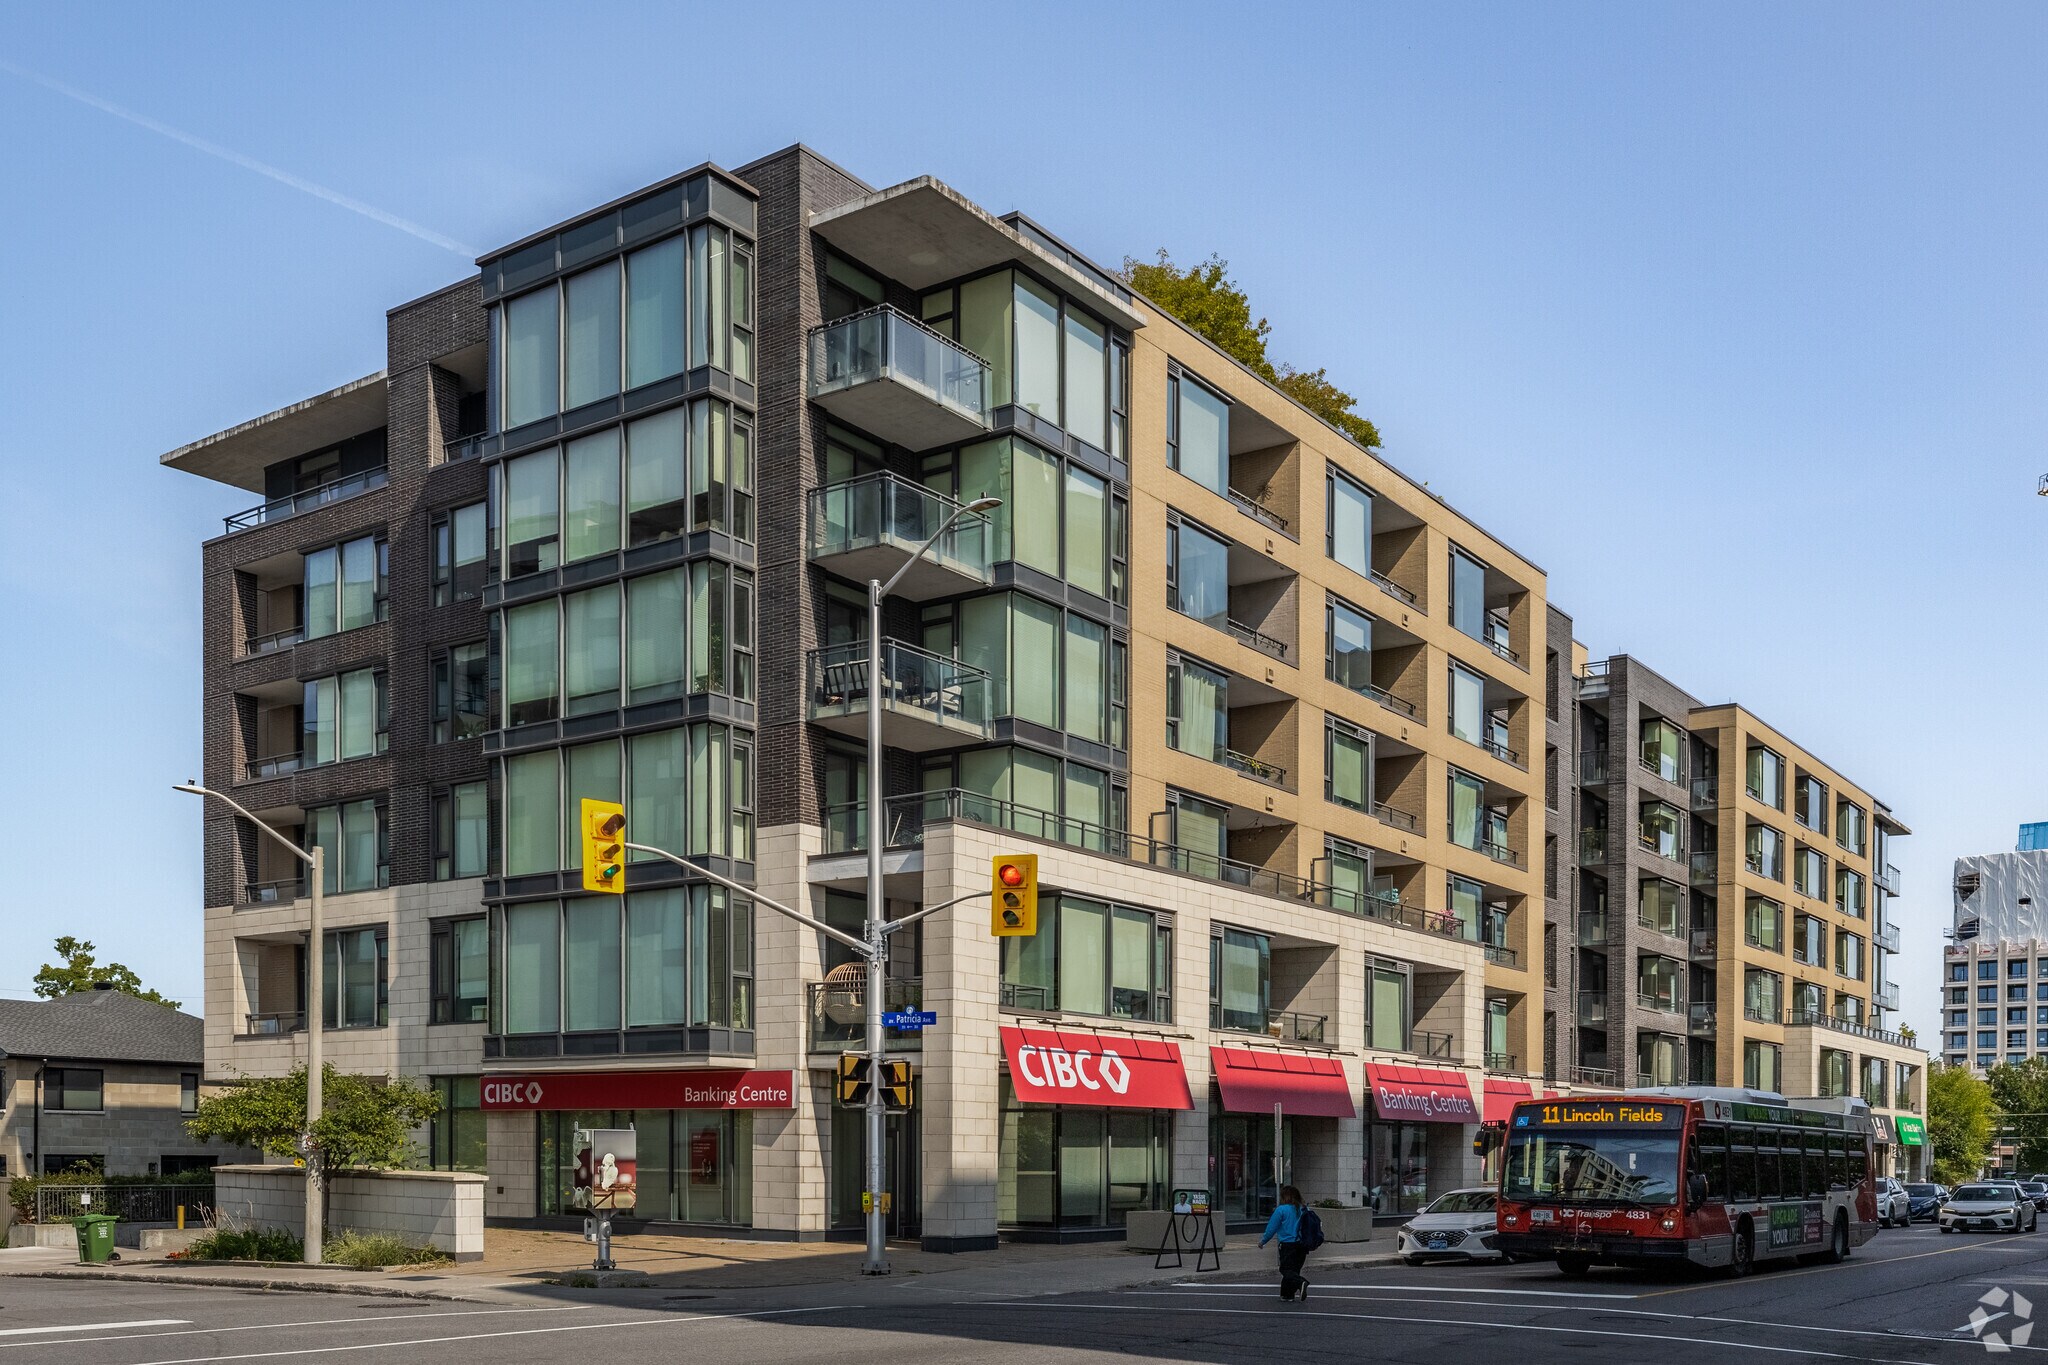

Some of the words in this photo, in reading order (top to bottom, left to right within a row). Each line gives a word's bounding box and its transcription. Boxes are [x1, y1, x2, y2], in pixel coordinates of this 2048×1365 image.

[896, 1014, 921, 1023] Patricia
[1018, 1044, 1100, 1090] CIBC
[484, 1083, 524, 1103] CIBC
[684, 1086, 736, 1104] Banking
[740, 1086, 787, 1101] Centre
[1380, 1086, 1432, 1116] Banking
[1430, 1090, 1471, 1114] Centre
[1542, 1106, 1560, 1123] 11
[1563, 1108, 1614, 1122] Lincoln
[1620, 1108, 1663, 1122] Fields
[1576, 1209, 1612, 1219] Transpo
[1626, 1210, 1650, 1220] 4831
[1772, 1228, 1789, 1244] YOUR
